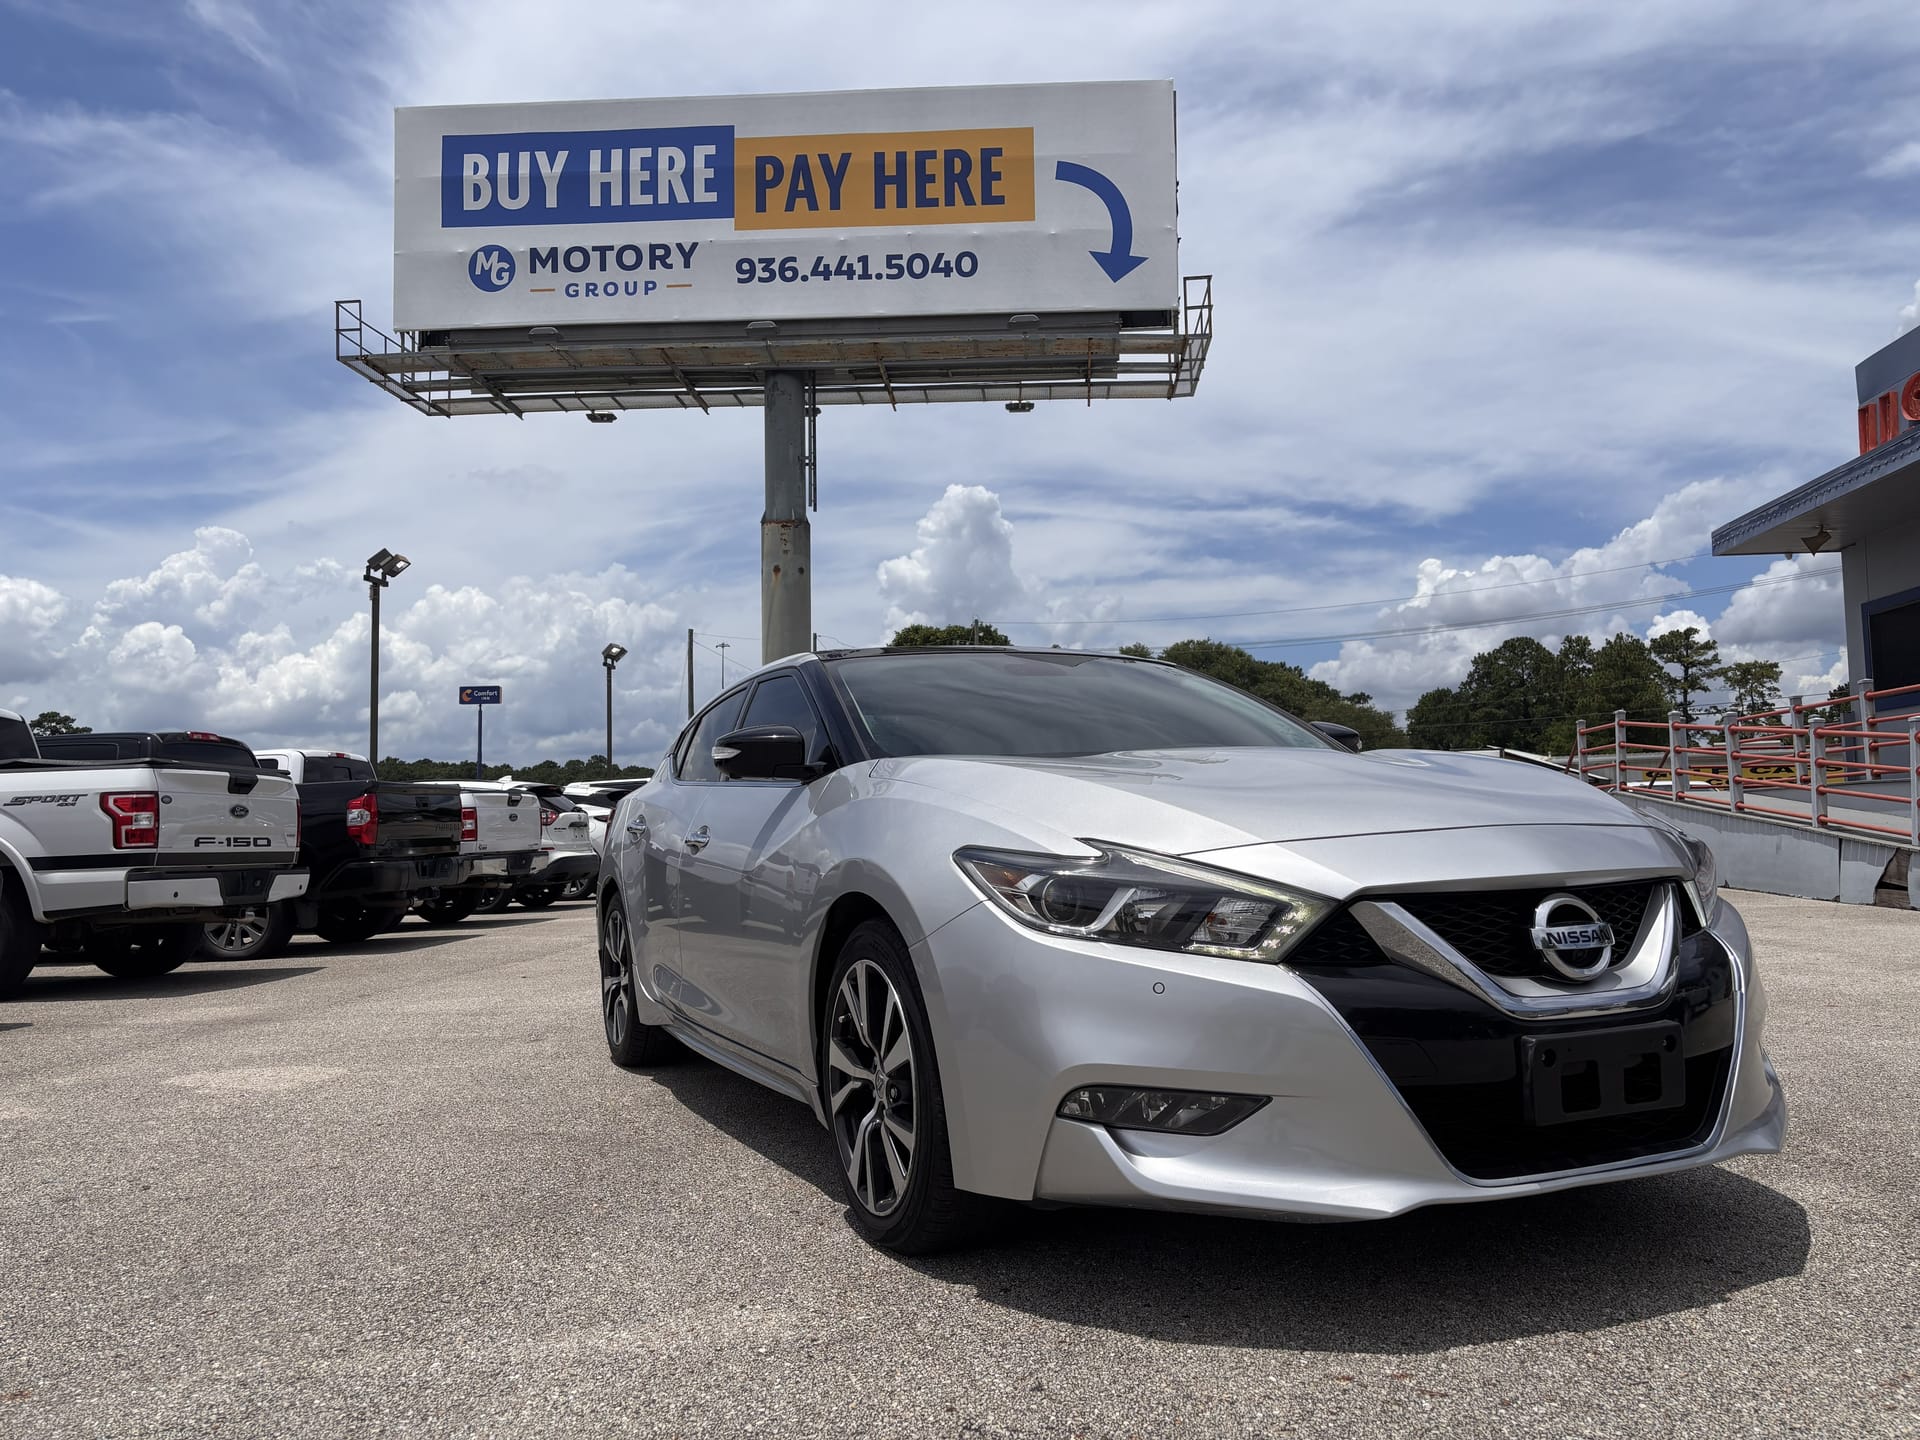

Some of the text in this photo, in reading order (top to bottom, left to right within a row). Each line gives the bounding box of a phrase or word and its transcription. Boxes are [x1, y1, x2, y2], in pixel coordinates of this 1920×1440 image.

[463, 144, 1006, 213] BUY HERE PAY HERE
[529, 241, 699, 274] MOTORY
[735, 250, 979, 284] 936.441.5040
[564, 280, 658, 298] GROUP
[3, 793, 89, 807] SPORT
[194, 836, 272, 848] F-150
[1545, 928, 1612, 945] NISSAN
